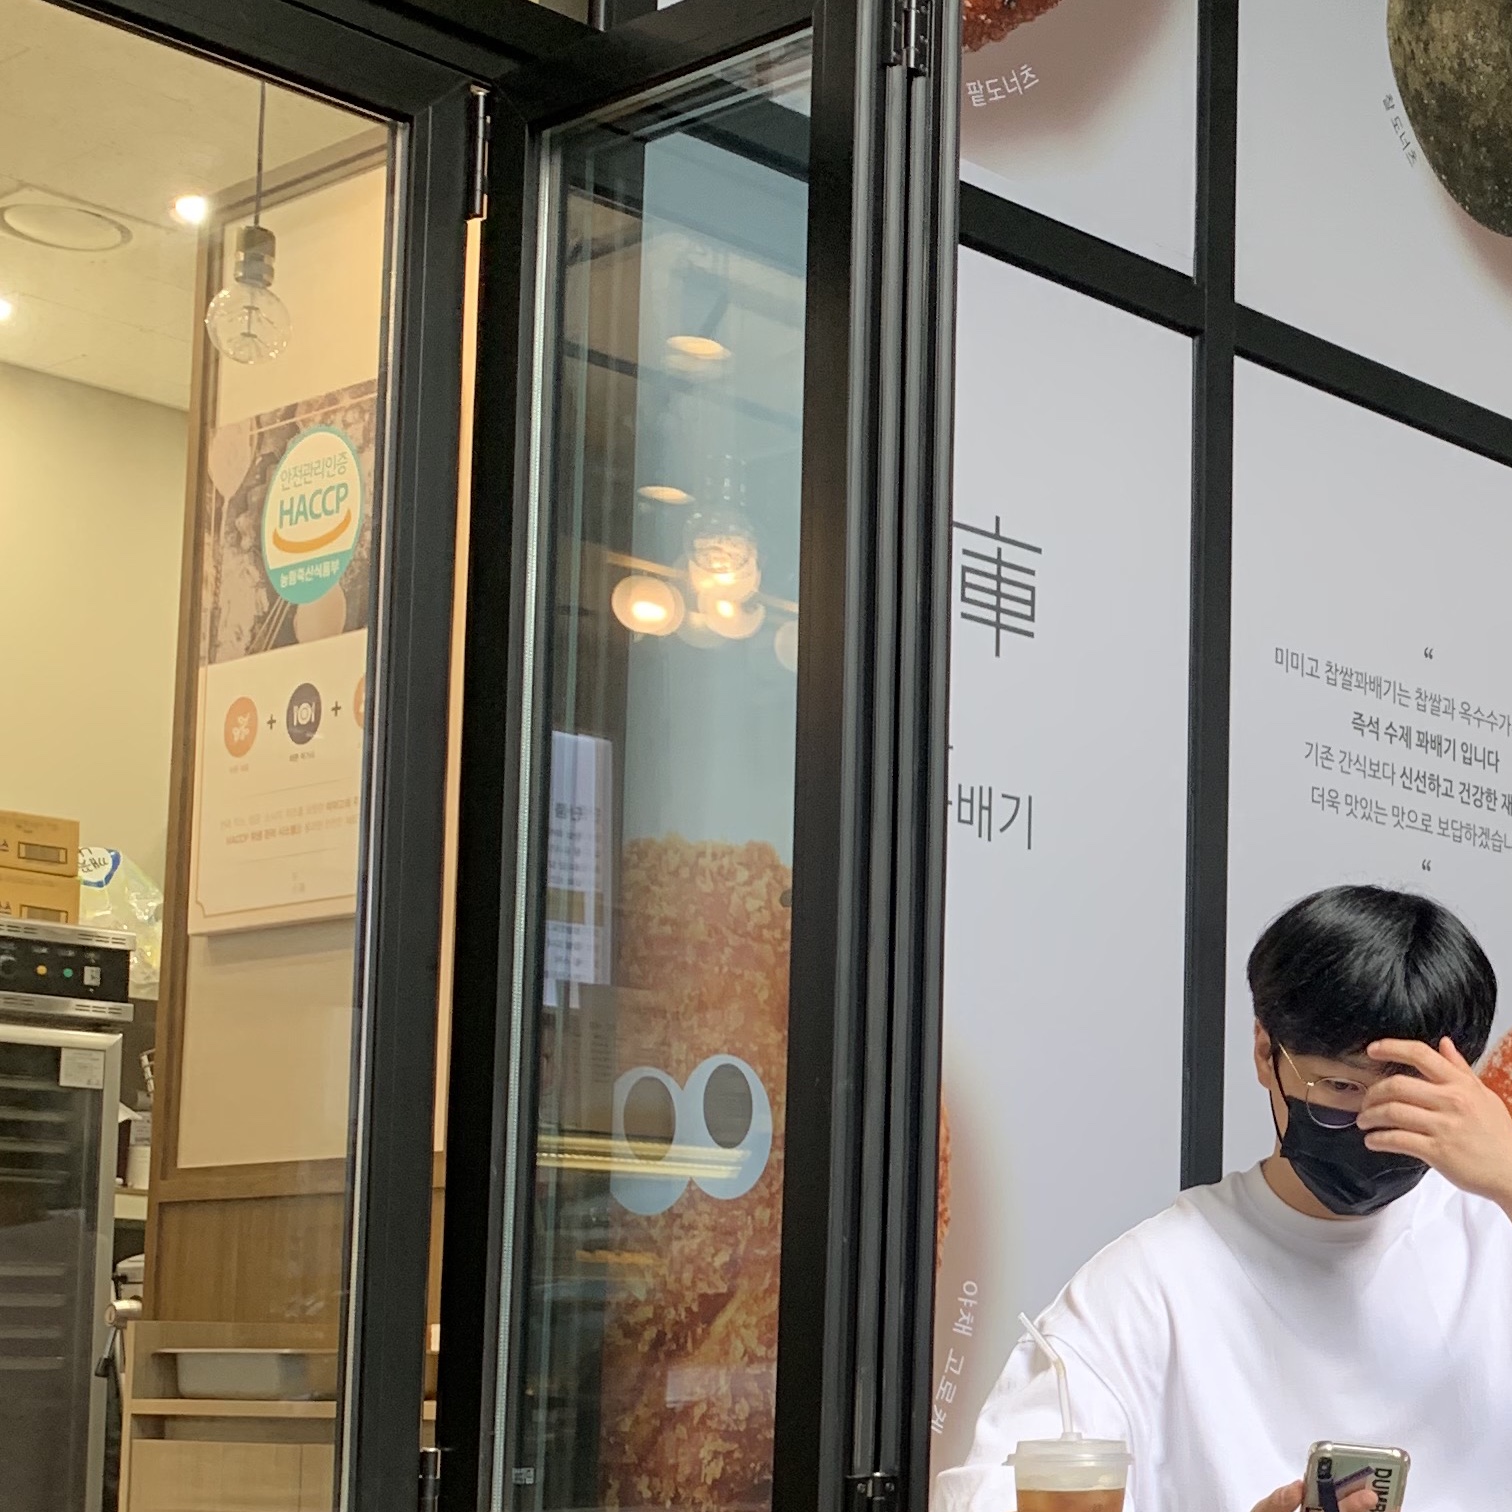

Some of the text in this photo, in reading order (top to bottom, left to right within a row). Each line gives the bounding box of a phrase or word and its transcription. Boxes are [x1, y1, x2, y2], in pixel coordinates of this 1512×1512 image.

[965, 63, 1040, 107] 팥도너츠
[279, 451, 349, 490] 안전관리인증
[278, 482, 349, 529] HACCP
[1274, 646, 1321, 680] 미미고
[1324, 660, 1412, 709] 찹쌀꽈배기는
[1414, 687, 1457, 722] 찹쌀과
[1350, 710, 1501, 774] 즉석 수제 꽈배기 입니다
[1304, 741, 1335, 771] 기존
[1338, 749, 1397, 787] 간식보다
[1399, 765, 1455, 799] 신선하고
[1458, 781, 1499, 813] 건강한
[948, 783, 1032, 850] 배기
[1311, 785, 1341, 815] 더욱
[1344, 793, 1389, 826] 맛있는
[1391, 805, 1434, 835] 맛으로
[931, 1280, 978, 1434] 야채 고로케
